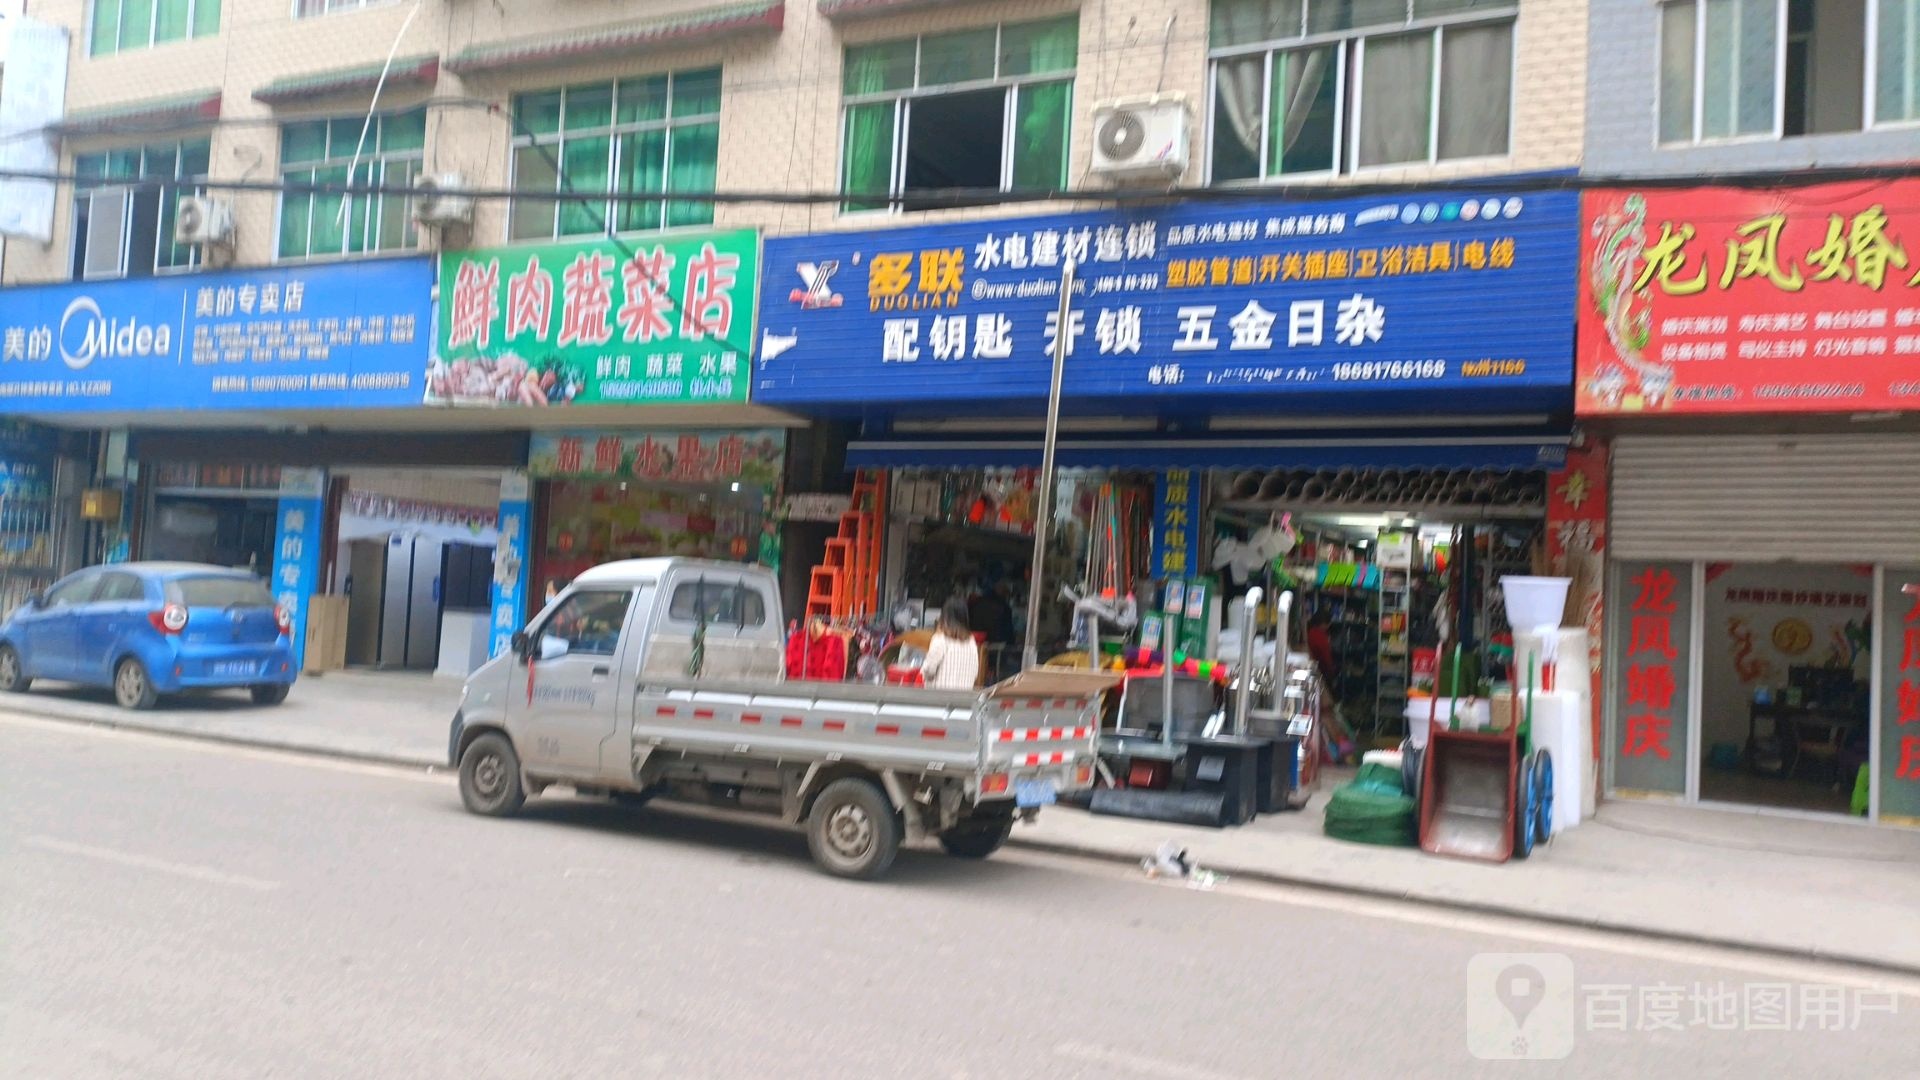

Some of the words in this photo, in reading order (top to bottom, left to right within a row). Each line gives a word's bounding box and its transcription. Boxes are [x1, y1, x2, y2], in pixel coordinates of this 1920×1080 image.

[867, 247, 965, 297] 多联
[973, 220, 1158, 272] 水电建材连锁
[1631, 204, 1920, 295] 龙凤婚
[195, 280, 305, 318] 美的专卖店
[448, 242, 741, 349] 鲜肉蔬菜店
[869, 294, 961, 313] DUOLIAN
[3, 325, 53, 363] 美的
[59, 296, 171, 370] Midea
[881, 312, 1013, 364] 配钥匙
[1043, 304, 1143, 357] 开锁
[1172, 293, 1386, 352] 五金日杂
[596, 354, 631, 380] 鲜肉
[646, 351, 683, 378] 蔬菜
[698, 350, 737, 377] 水果
[1331, 358, 1447, 382] 18681766168
[1163, 469, 1190, 582] 品质水电建
[1621, 566, 1678, 760] 龙凤婚庆
